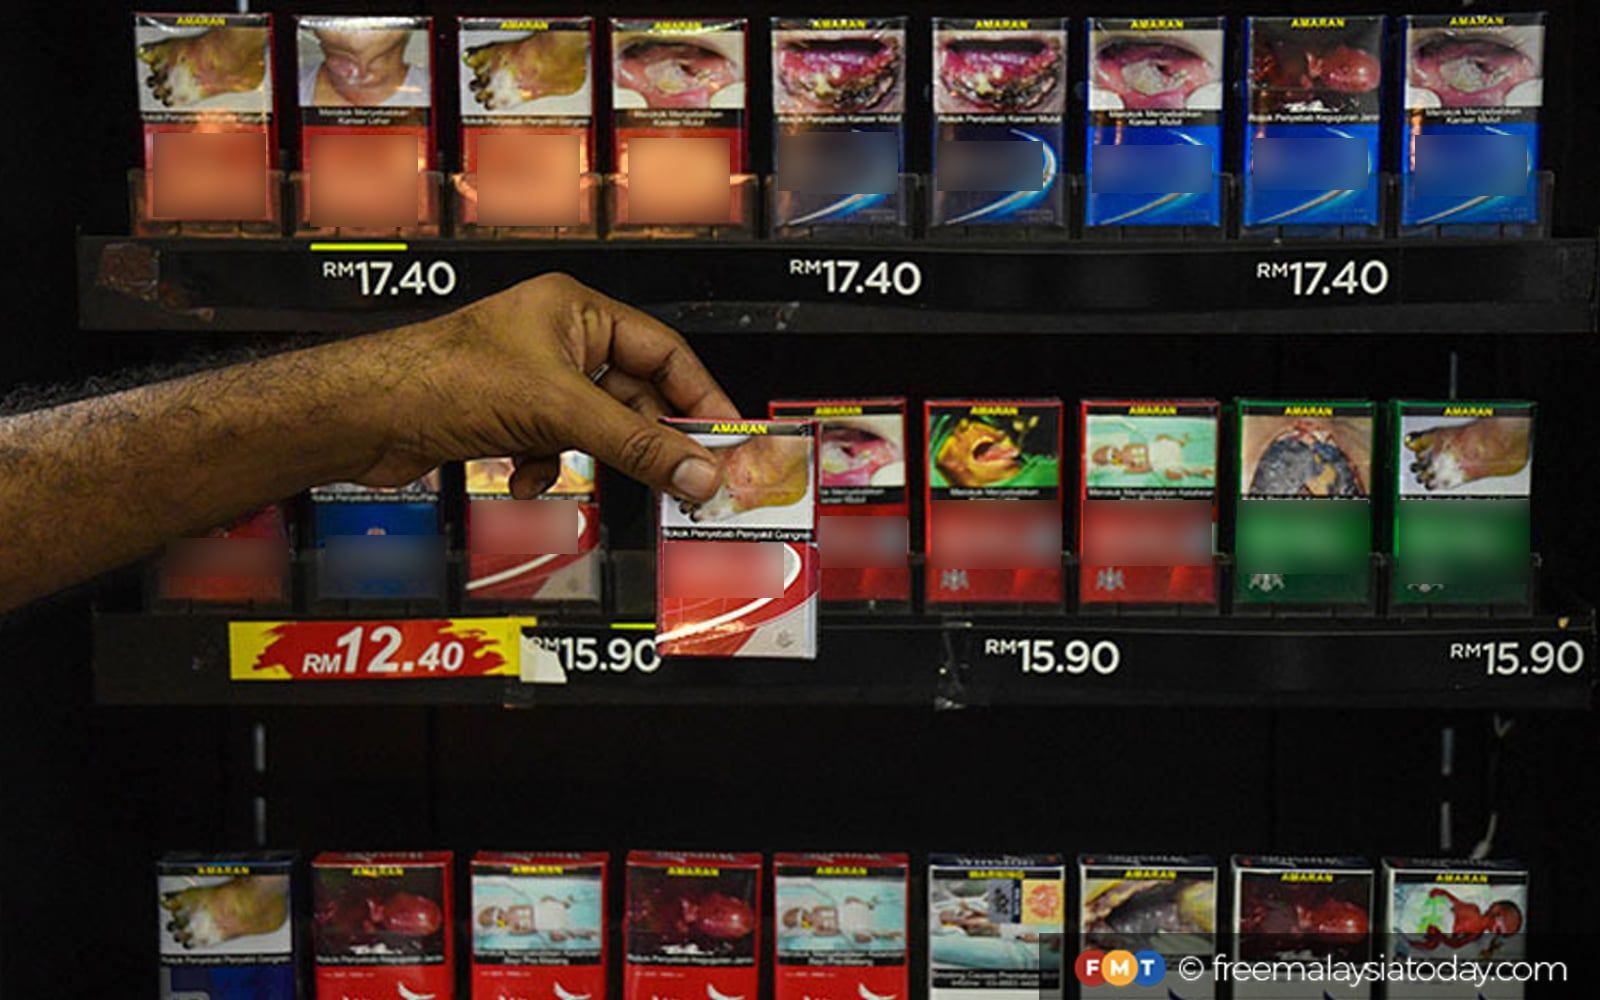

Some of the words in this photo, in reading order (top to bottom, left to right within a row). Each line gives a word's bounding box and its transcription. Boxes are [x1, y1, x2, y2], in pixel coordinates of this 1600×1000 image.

[975, 19, 1029, 30] AMARAN
[1130, 19, 1184, 30] AMARAN
[1291, 17, 1346, 28] AMARAN
[323, 261, 457, 296] RM17.40
[789, 260, 922, 296] RM17.40
[1256, 260, 1389, 296] RM17.40
[1284, 407, 1334, 416] AMARAN
[1443, 407, 1494, 417] AMARAN
[711, 423, 768, 434] AMARAN
[302, 626, 465, 674] RM12.40
[985, 639, 1120, 674] RM15.90
[1450, 640, 1585, 675] RM15.90
[1124, 869, 1177, 879] AMARAN
[1281, 872, 1333, 882] AMARAN
[1435, 873, 1488, 883] AMARAN
